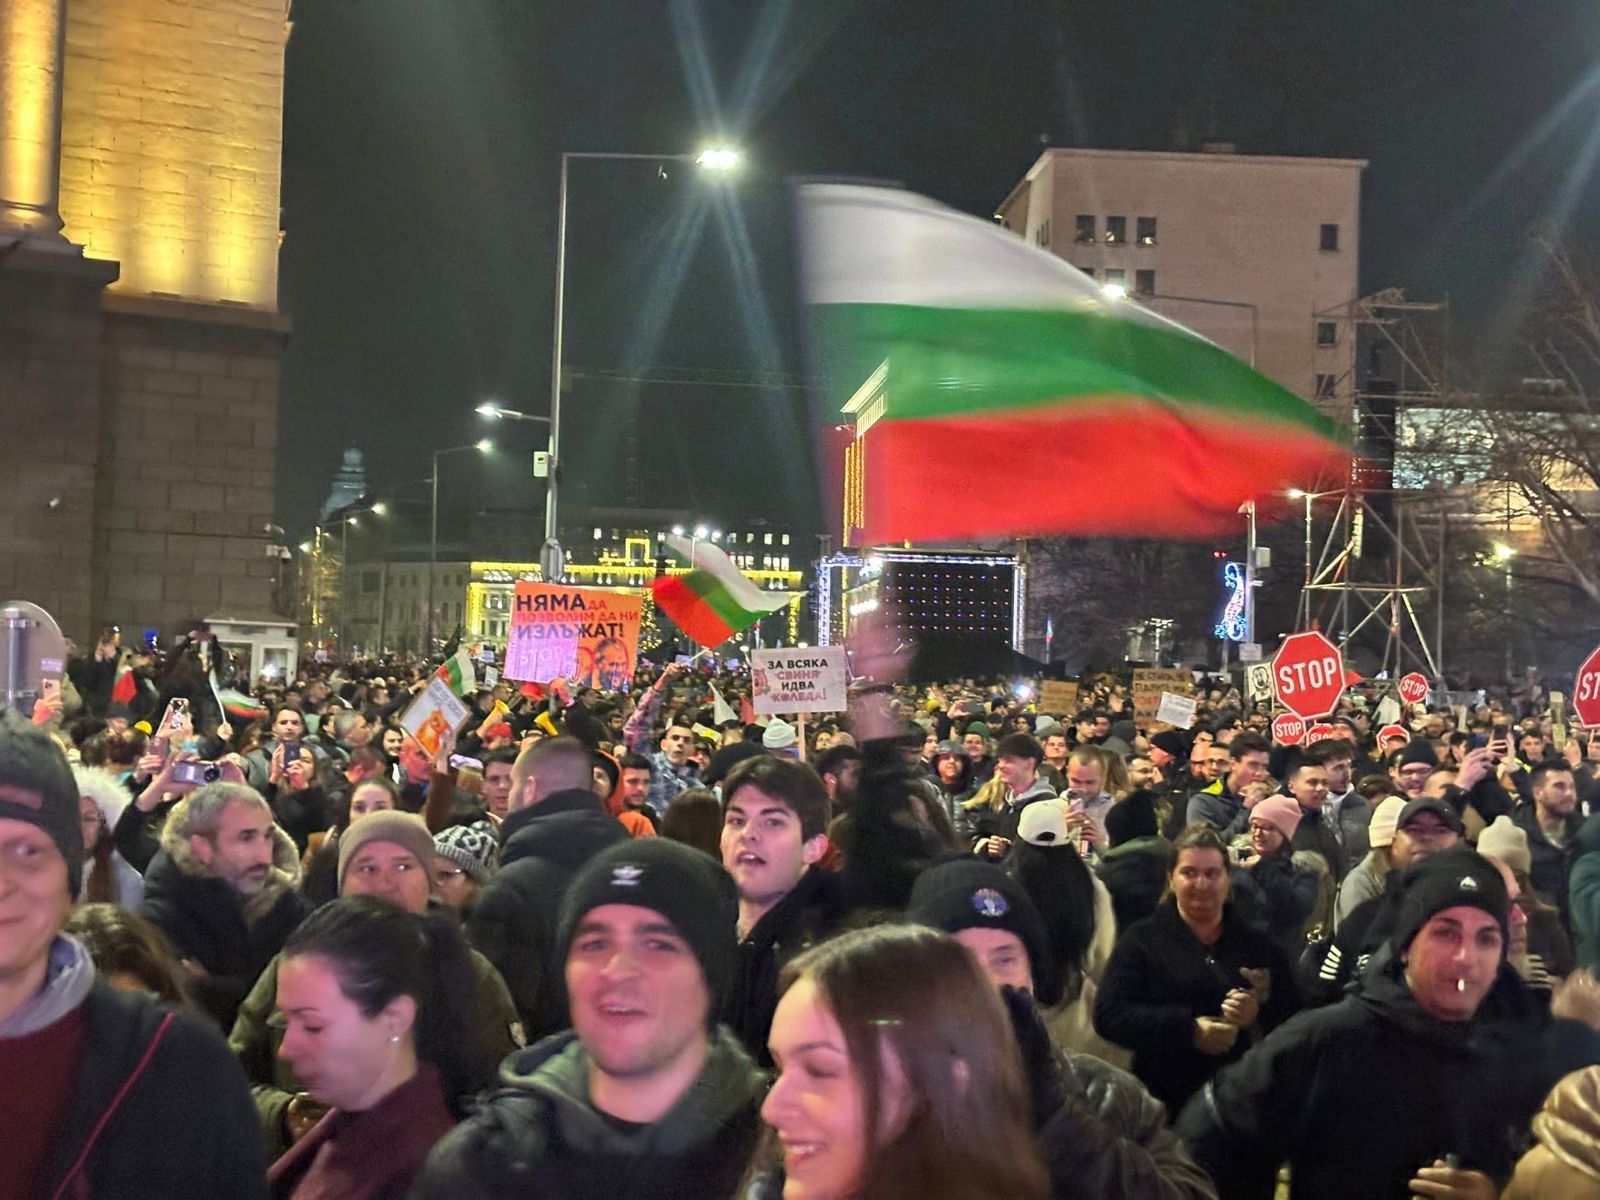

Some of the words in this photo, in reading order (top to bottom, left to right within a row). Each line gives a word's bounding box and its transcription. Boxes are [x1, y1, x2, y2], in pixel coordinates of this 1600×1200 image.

[516, 594, 586, 611] НЯМА
[588, 600, 608, 610] ДА
[598, 612, 617, 622] ДА
[620, 611, 638, 621] НИ
[517, 623, 624, 640] ИЗЛЪЖАТ!
[767, 660, 784, 669] ЗА
[787, 659, 828, 668] ВСЯКА
[1279, 657, 1337, 695] STOP
[781, 681, 815, 691] ИДВА
[1402, 679, 1425, 697] STOP
[1276, 722, 1302, 737] STOP
